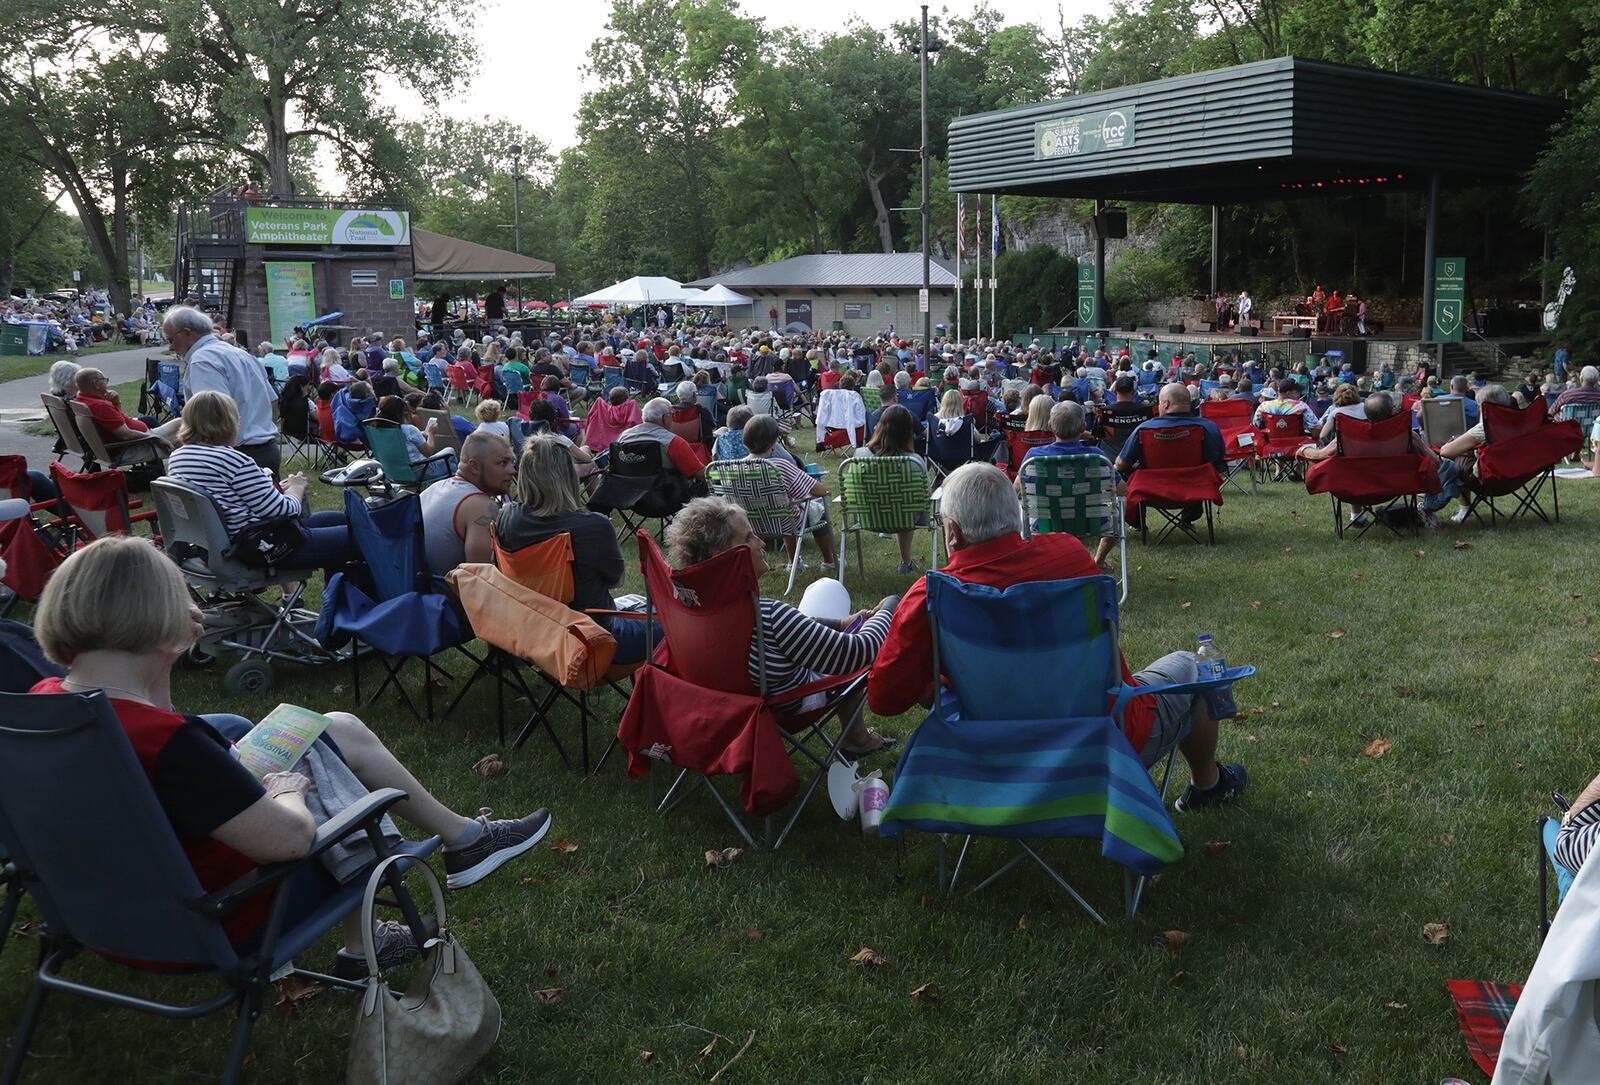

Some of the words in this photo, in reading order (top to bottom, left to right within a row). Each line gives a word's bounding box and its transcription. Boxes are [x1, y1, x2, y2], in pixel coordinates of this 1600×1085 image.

[1054, 127, 1080, 137] SUMMER
[1104, 125, 1126, 139] TCC
[1055, 134, 1080, 147] ARTS
[1054, 146, 1080, 156] FESTIVAL
[261, 211, 313, 220] Welcome
[316, 211, 327, 220] to
[251, 221, 300, 231] Veterans
[303, 222, 328, 231] Park
[251, 231, 328, 241] Amphitheater
[1442, 305, 1454, 323] S
[1108, 415, 1148, 424] BENGALS
